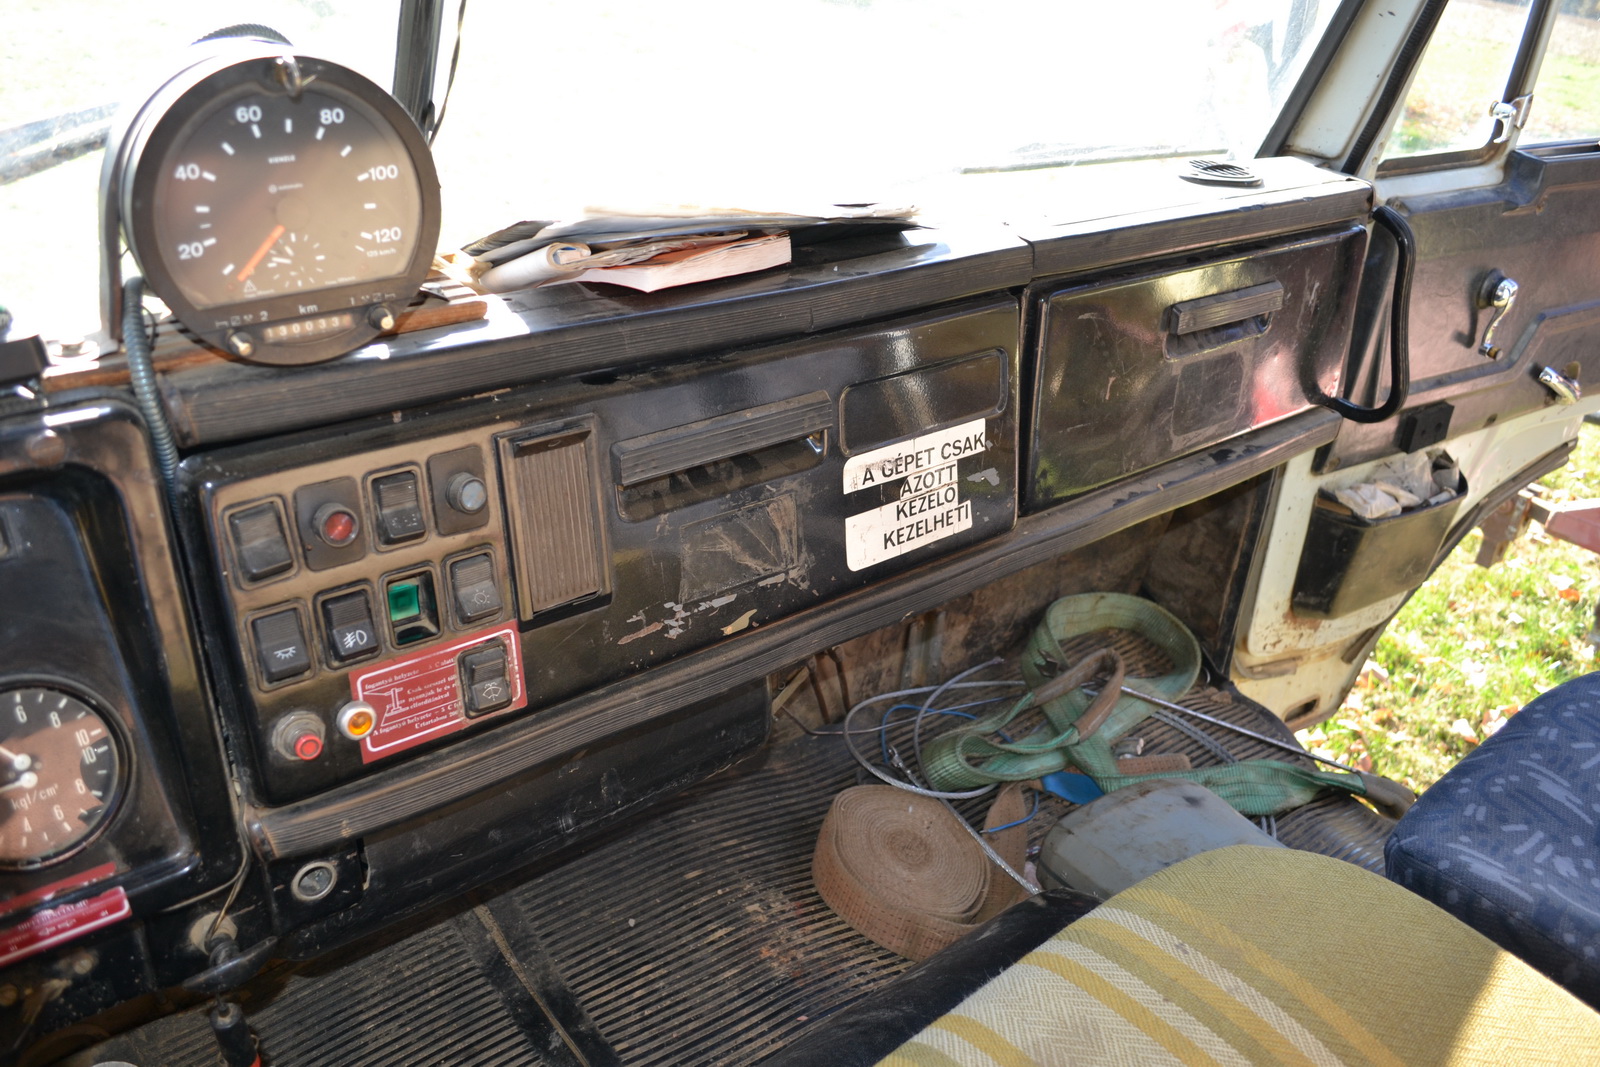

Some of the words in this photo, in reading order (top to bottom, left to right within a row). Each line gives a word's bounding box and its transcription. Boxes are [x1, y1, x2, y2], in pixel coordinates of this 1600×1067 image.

[236, 105, 262, 123] 60
[320, 107, 345, 125] 80
[175, 163, 200, 180] 40
[368, 164, 398, 180] 100
[373, 227, 401, 243] 120
[178, 241, 204, 260] 20
[260, 311, 269, 321] 2
[298, 304, 318, 314] km
[862, 467, 875, 486] A
[881, 447, 936, 478] GÉPET
[941, 432, 986, 460] CSAK
[901, 464, 957, 497] AZOTT
[884, 504, 969, 550] KEZELHETI
[15, 705, 27, 723] 6
[50, 711, 61, 728] 8
[75, 728, 90, 747] 10
[82, 746, 96, 765] 10
[75, 778, 85, 795] 8
[53, 804, 64, 820] 6
